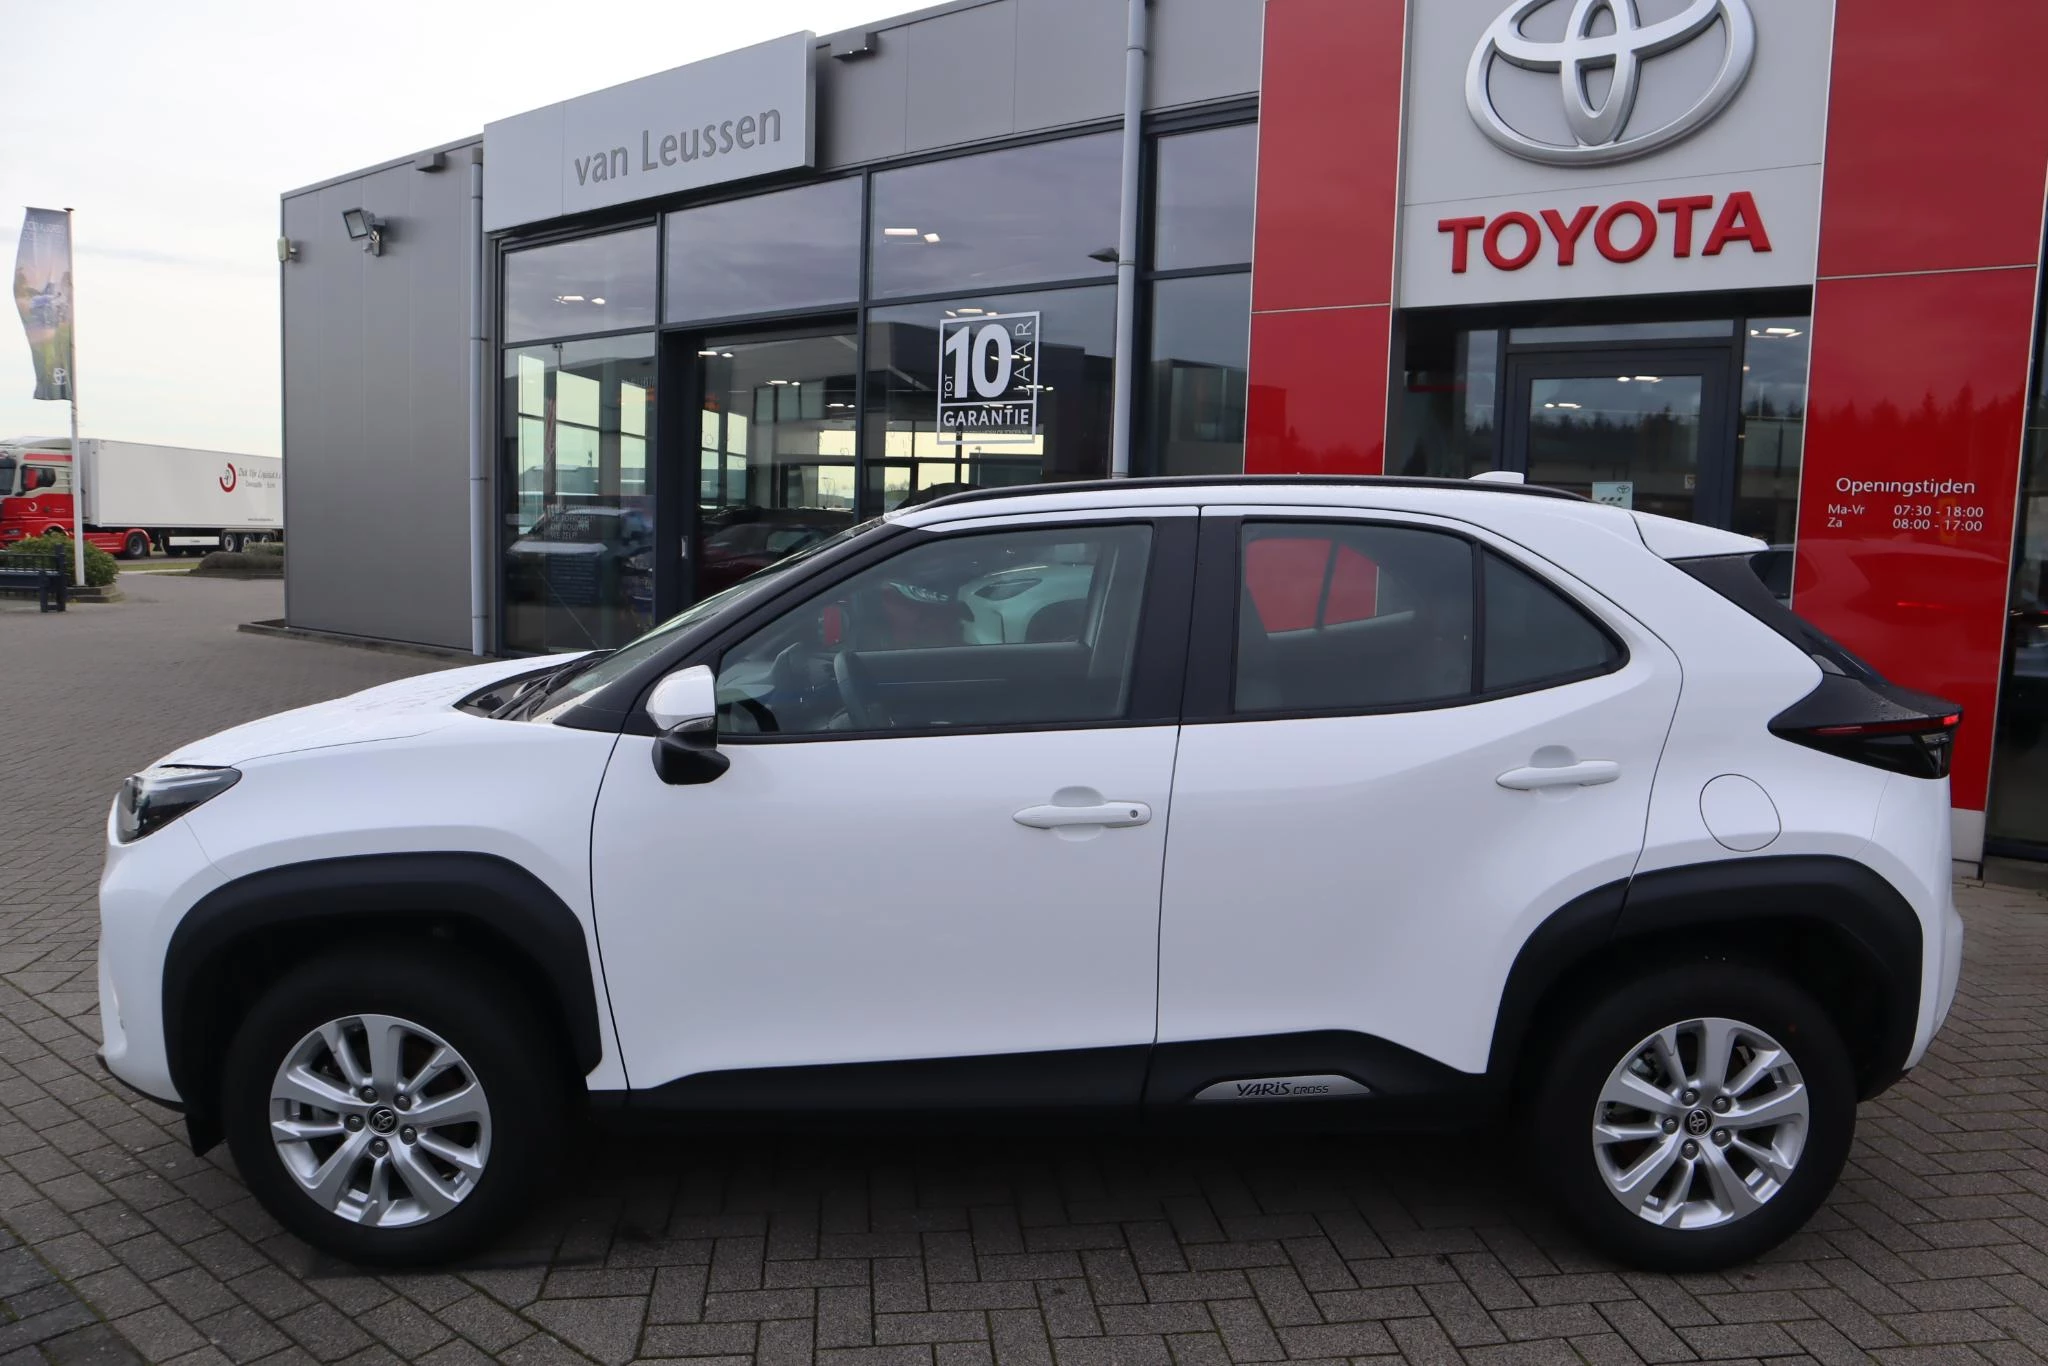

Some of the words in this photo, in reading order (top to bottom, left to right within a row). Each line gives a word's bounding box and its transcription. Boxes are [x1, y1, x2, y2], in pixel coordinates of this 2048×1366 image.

[574, 145, 628, 187] van
[641, 108, 782, 172] Leussen
[1438, 191, 1772, 274] TOYOTA
[945, 323, 1012, 399] 10
[1013, 320, 1032, 396] JAAR
[944, 374, 953, 399] TOT
[943, 408, 1029, 427] GARANTIE
[1836, 477, 1976, 498] Openingstijden
[1828, 504, 1865, 515] Ma-Vr
[1894, 504, 1932, 516] 07:30
[1946, 506, 1984, 518] 18:00
[1827, 517, 1843, 528] Za
[1892, 518, 1930, 530] 08:00
[1945, 520, 1983, 532] 17:00
[1293, 1085, 1329, 1095] CROSS
